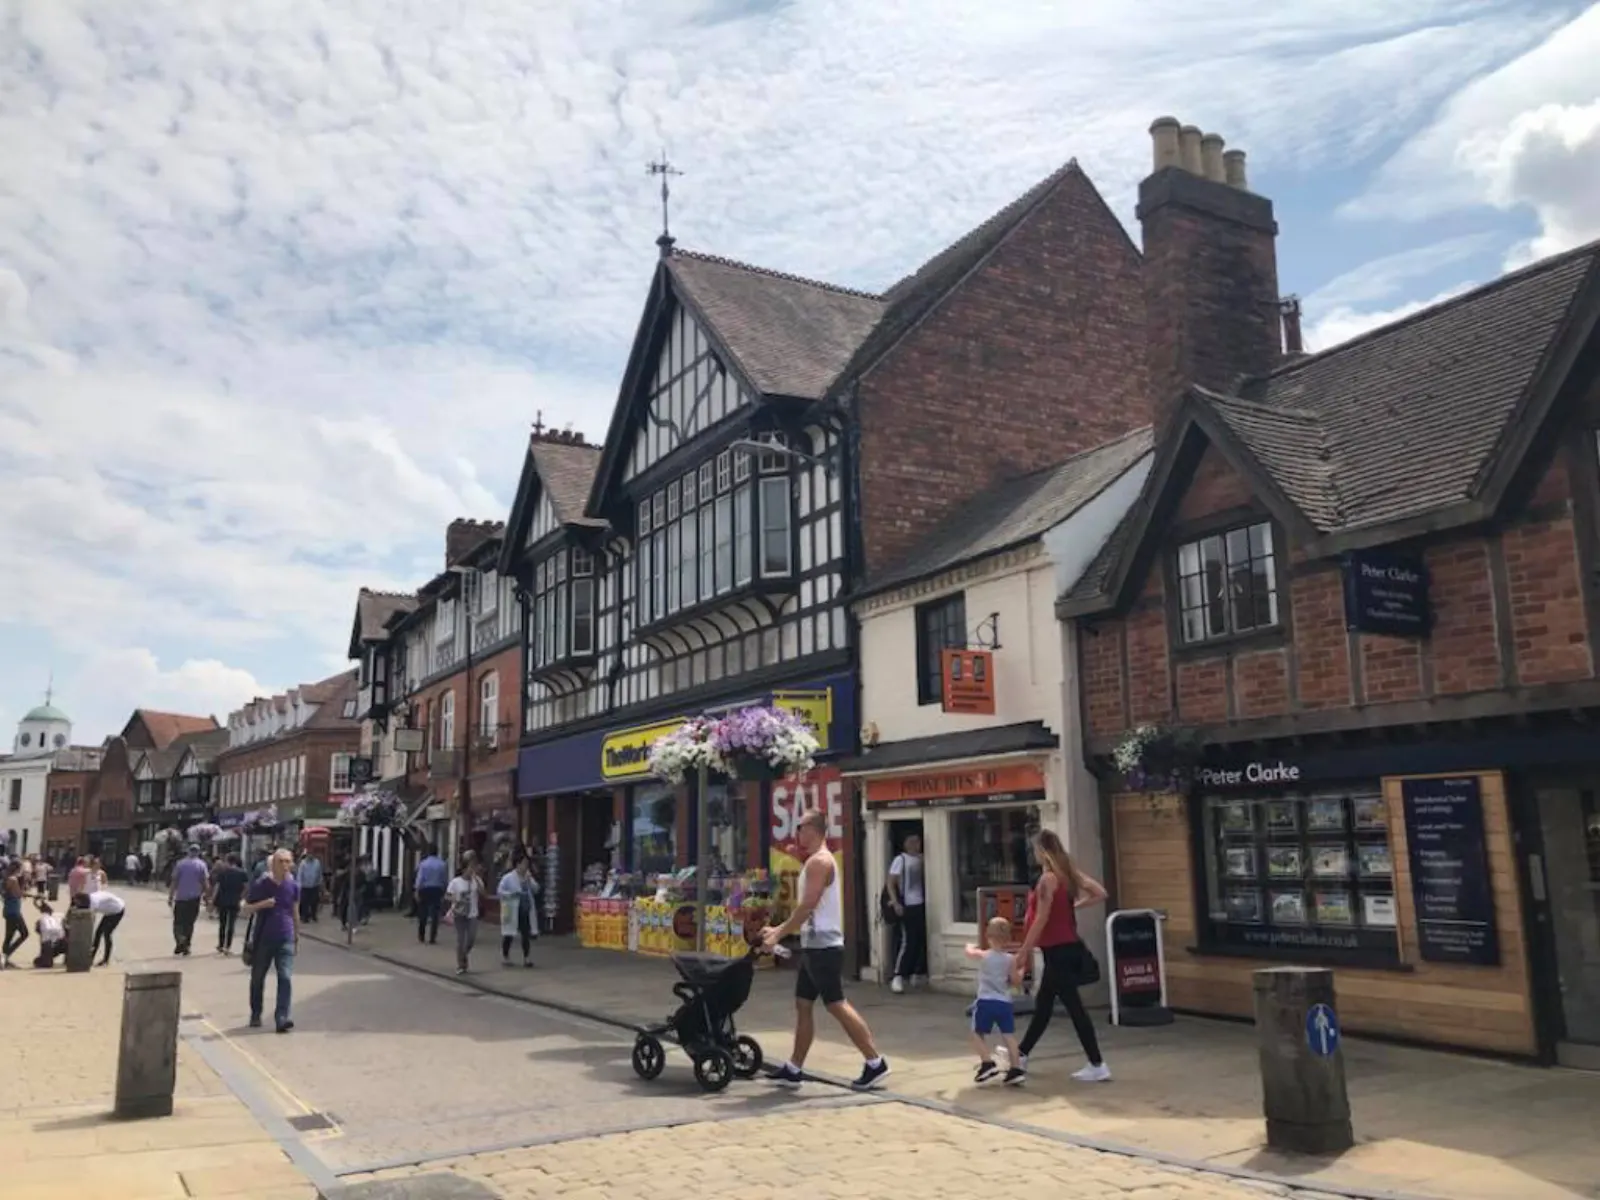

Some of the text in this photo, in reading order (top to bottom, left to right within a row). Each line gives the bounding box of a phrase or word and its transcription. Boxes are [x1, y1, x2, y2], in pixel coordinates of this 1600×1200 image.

[791, 706, 812, 719] The
[606, 739, 653, 768] TheWork
[1200, 761, 1300, 785] Peter Clarke
